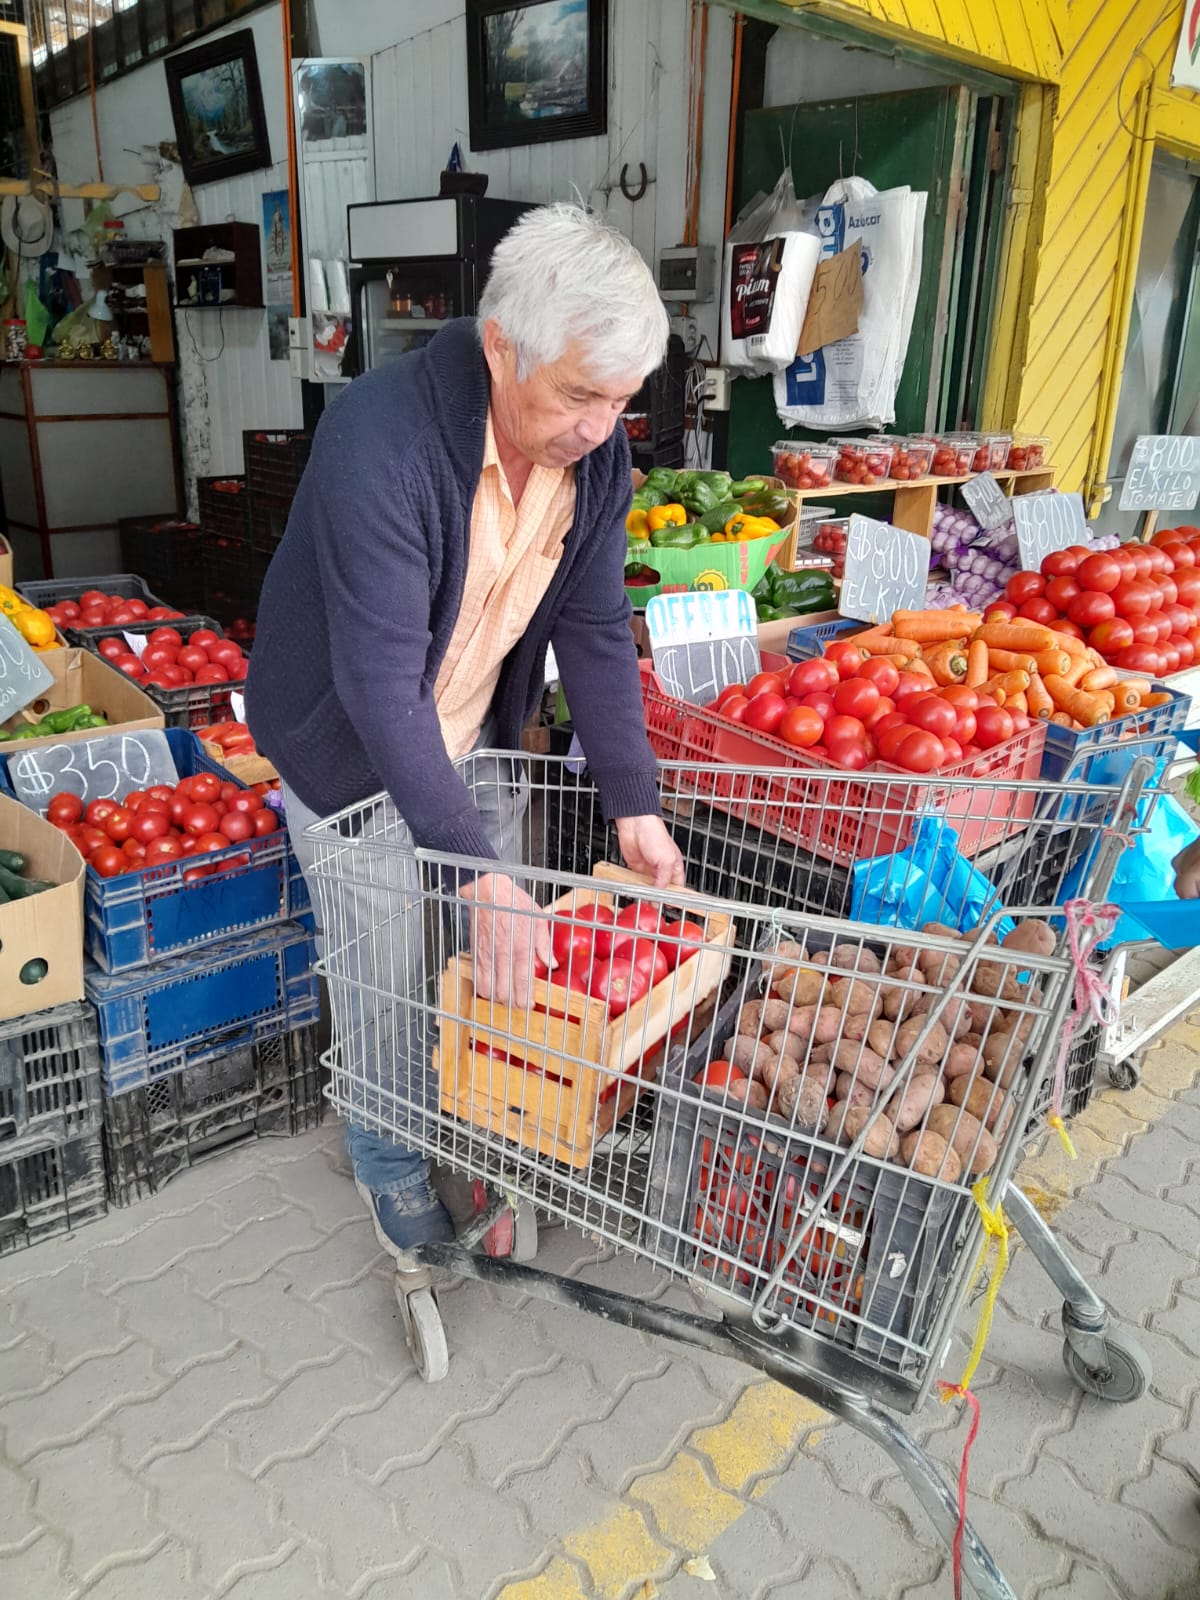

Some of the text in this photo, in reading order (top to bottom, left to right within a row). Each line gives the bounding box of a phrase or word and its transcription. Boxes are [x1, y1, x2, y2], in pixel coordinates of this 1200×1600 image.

[848, 213, 881, 229] Azúcar
[1136, 435, 1194, 472] $800
[1018, 495, 1077, 550] $800
[848, 519, 919, 588] $800
[649, 591, 753, 641] OFERTA
[845, 575, 872, 609] EL
[660, 636, 760, 701] $400
[16, 736, 150, 801] $350
